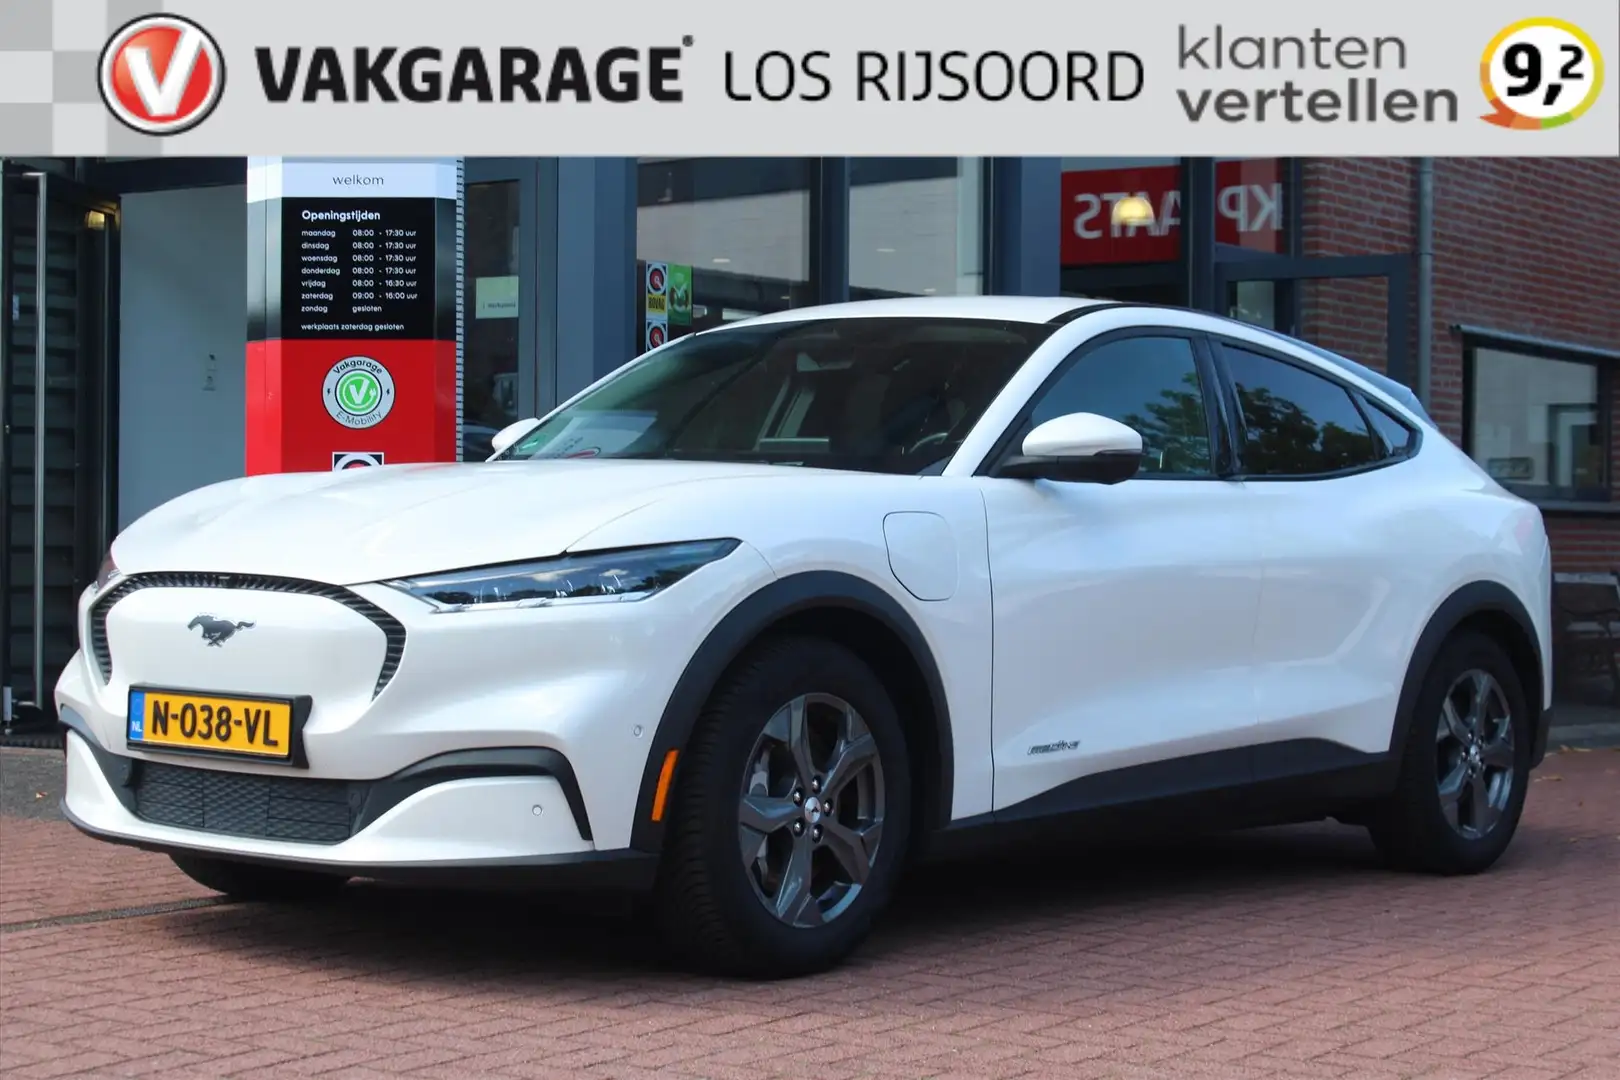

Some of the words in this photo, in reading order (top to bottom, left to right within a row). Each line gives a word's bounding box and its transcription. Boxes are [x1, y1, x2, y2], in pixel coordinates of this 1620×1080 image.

[332, 174, 384, 186] welkom
[301, 209, 381, 222] Openingstijden
[301, 229, 336, 238] maandag
[352, 228, 375, 237] 08:00
[405, 229, 417, 237] uur
[301, 242, 330, 251] dinsdag
[352, 241, 375, 250] 08:00
[405, 242, 417, 250] uur
[301, 254, 338, 263] woensdag
[352, 254, 375, 263] 08:00
[405, 255, 417, 263] uur
[301, 267, 341, 276] donderdag
[352, 266, 375, 275] 08:00
[405, 267, 417, 275] uur
[301, 279, 327, 289] vrijdag
[352, 279, 375, 288] 08:00
[405, 280, 417, 288] uur
[301, 292, 334, 301] zaterdag
[352, 291, 375, 300] 09:00
[406, 292, 418, 300] uur
[301, 304, 328, 314] zondag
[352, 304, 383, 314] gesloten
[301, 322, 340, 332] werkplaats
[341, 323, 374, 332] zaterdag
[374, 323, 405, 332] gesloten
[333, 360, 383, 374] Vakgarage
[336, 410, 382, 425] E-Mobility
[132, 721, 143, 732] NL
[152, 700, 279, 747] N-038-VL
